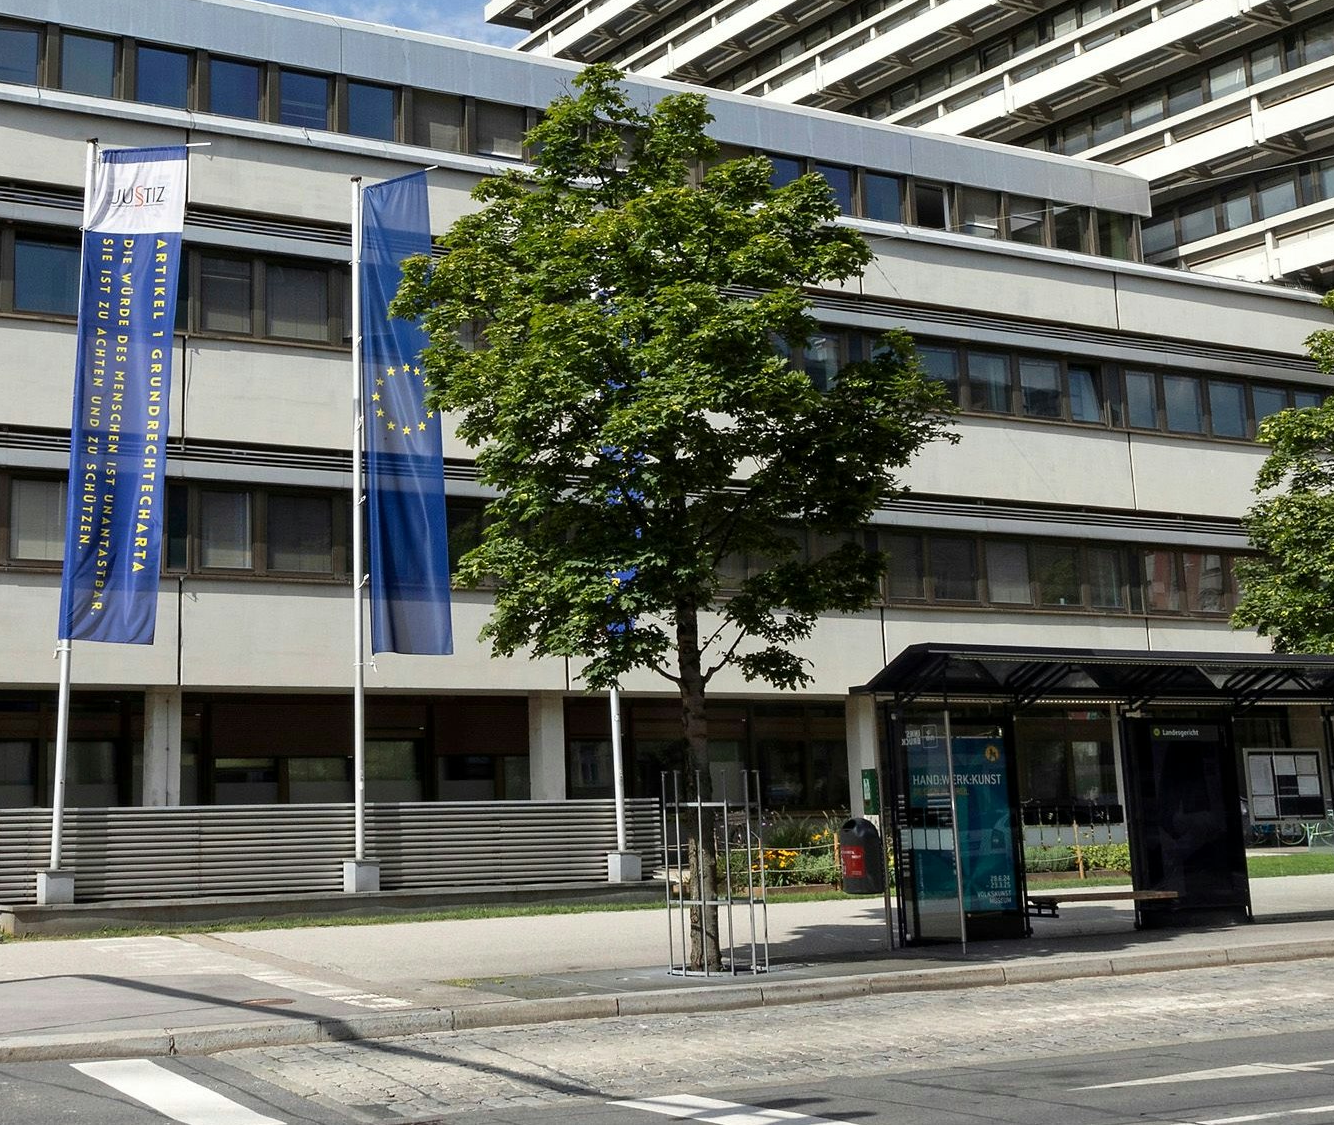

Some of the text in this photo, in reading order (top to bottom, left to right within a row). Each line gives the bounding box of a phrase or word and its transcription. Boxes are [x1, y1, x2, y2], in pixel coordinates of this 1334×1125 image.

[153, 239, 168, 319] ARTIKEL
[78, 238, 114, 550] SIE IST ZU ACHTEN UND ZU SCHÜTZEN.
[91, 239, 134, 615] DIE WÜRDE DES MENSCHEN IST UNANTASTBAR.
[132, 349, 163, 572] GRUNDRECHTECHARTA
[1162, 729, 1199, 737] Landesgericht
